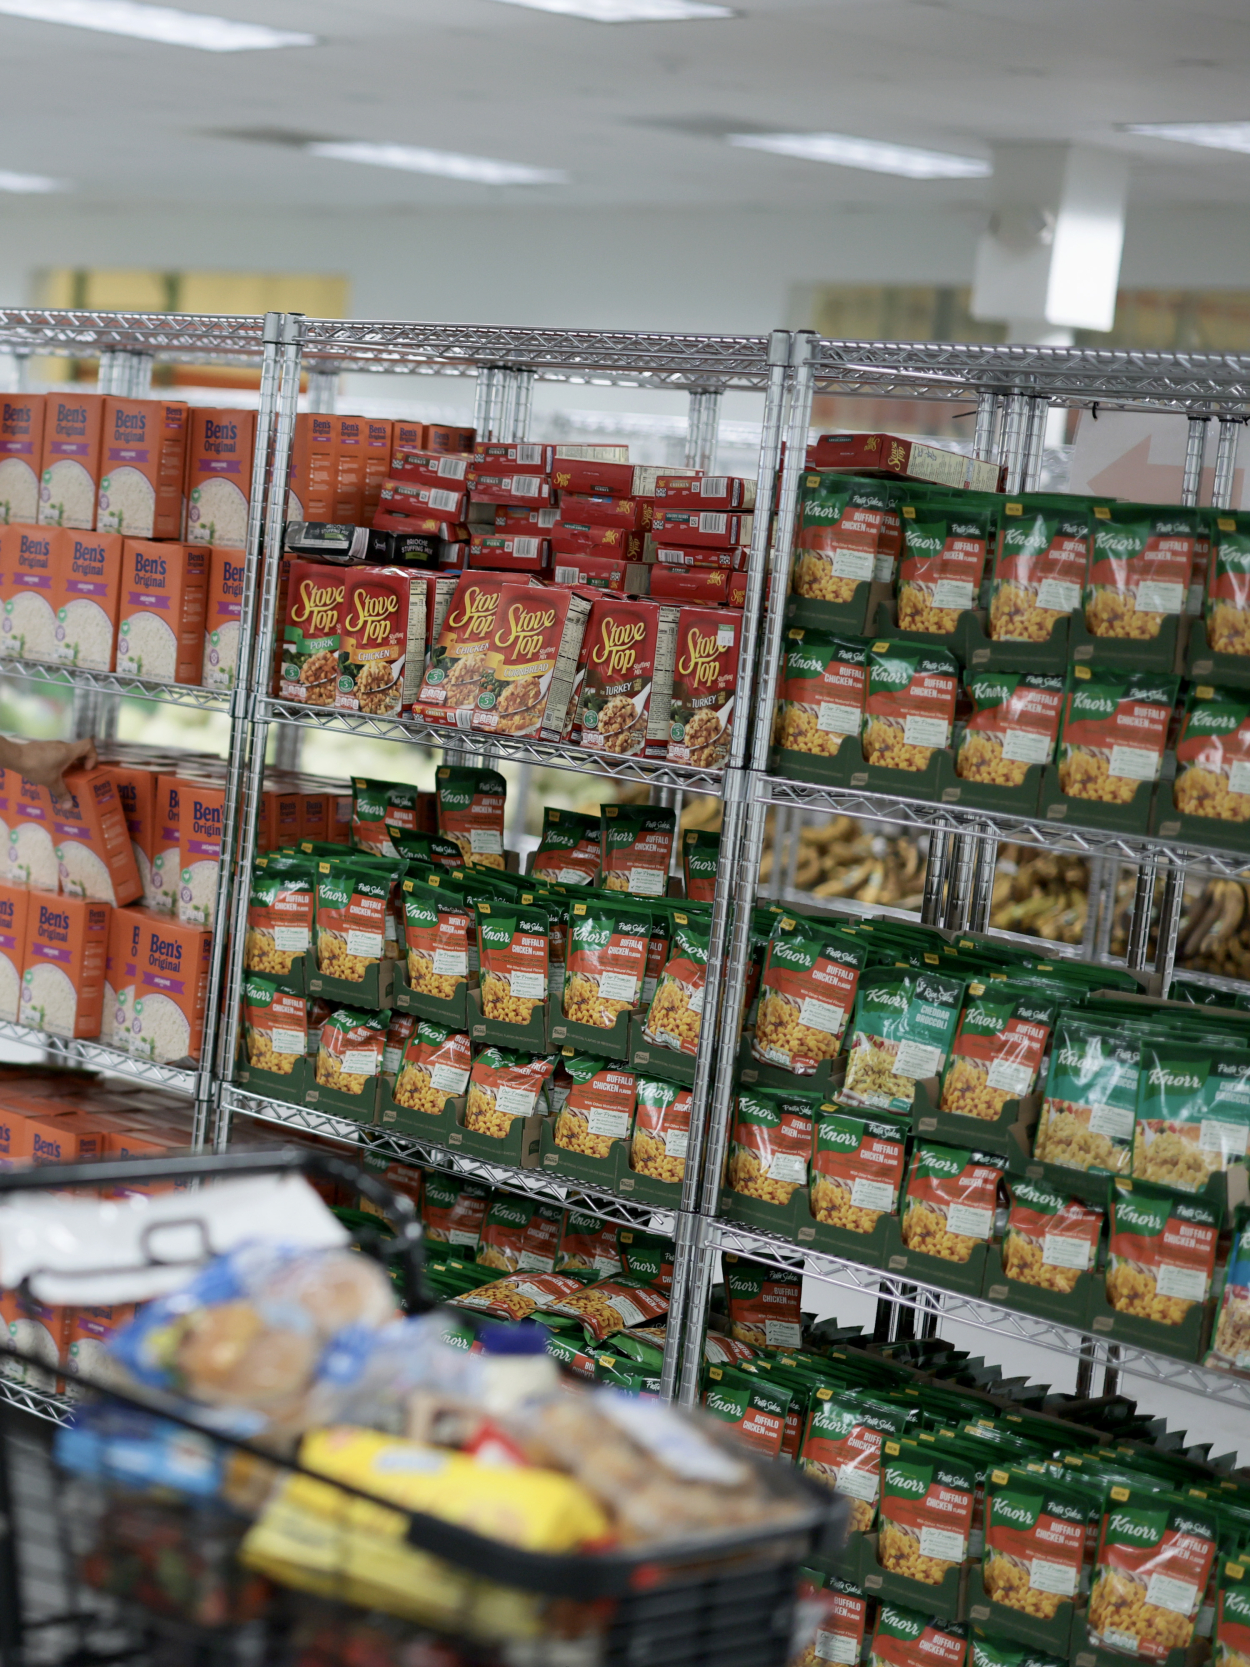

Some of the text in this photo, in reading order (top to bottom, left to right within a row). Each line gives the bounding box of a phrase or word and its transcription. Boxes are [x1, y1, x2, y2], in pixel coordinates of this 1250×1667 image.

[3, 404, 31, 422] Ben's
[57, 404, 86, 423] Ben's
[115, 410, 146, 429] Ben's
[114, 430, 144, 443] Original
[205, 420, 237, 440] Ben's
[204, 440, 236, 454] Original
[804, 500, 840, 520] Knorr
[854, 512, 880, 523] BUFFALO
[841, 521, 865, 532] CHICKEN
[20, 535, 49, 556] Ben's
[407, 538, 429, 548] BRIOCHE
[905, 531, 942, 550] Knorr
[1095, 532, 1142, 550] Knorr
[73, 541, 105, 562] Ben's
[72, 561, 103, 576] Original
[135, 553, 166, 575] Ben's
[134, 573, 165, 588] Original
[291, 580, 345, 622] Stove
[449, 587, 500, 627] Stov
[345, 589, 398, 631] Stove
[309, 608, 338, 633] Top
[495, 604, 555, 647] Stove
[362, 617, 391, 644] Top
[310, 639, 334, 649] PORK
[456, 643, 490, 654] CHICKEN
[511, 634, 543, 660] Top
[593, 618, 646, 663] Stove
[358, 650, 390, 661] CHICKEN
[607, 648, 635, 676] Top
[788, 653, 824, 672] Knorr
[504, 663, 549, 678] CORNBREAD
[693, 660, 719, 688] Top
[870, 666, 909, 684] Knorr
[824, 674, 853, 686] CHICKEN
[924, 678, 953, 690] BUFFALO
[606, 683, 632, 696] TURKEY
[910, 686, 937, 697] CHICKEN
[692, 695, 717, 708] TURKEY
[1073, 692, 1114, 712] Knorr
[1134, 706, 1166, 720] BUFFALO
[1190, 711, 1238, 728] Knorr
[1117, 715, 1149, 728] CHICKEN
[319, 885, 348, 903] Knorr
[274, 902, 297, 910] CHICKEN
[350, 906, 371, 916] CHICKEN
[361, 899, 382, 910] BUFFALO
[405, 903, 438, 922] Knorr
[39, 906, 69, 930] Ben's
[38, 925, 68, 943] Original
[481, 925, 510, 943] Knorr
[522, 937, 544, 947] BUFFALO
[573, 927, 610, 944] Knorr
[150, 933, 182, 960] Ben's
[512, 945, 532, 955] CHICKEN
[608, 946, 629, 956] CHICKEN
[773, 941, 812, 967] Knorr
[149, 954, 181, 973] Original
[812, 970, 838, 985] CHICKEN
[826, 965, 854, 980] BUFFALO
[246, 984, 271, 1002] Knorr
[272, 1004, 294, 1014] CHICKEN
[283, 998, 303, 1008] BUFFALO
[921, 1005, 950, 1020] CHEDDAR
[965, 1008, 1004, 1029] Knorr
[916, 1013, 948, 1030] BROCCOLI
[1016, 1024, 1044, 1038] BUFFALO
[593, 1081, 618, 1092] CHICKEN
[606, 1074, 633, 1085] BUFFALO
[738, 1097, 780, 1123] Knorr
[818, 1124, 858, 1147] Knorr
[860, 1150, 883, 1163] CHICKEN
[872, 1143, 898, 1156] BUFFALO
[1115, 1204, 1163, 1230] Knorr
[1163, 1233, 1195, 1248] CHICKEN
[1179, 1225, 1212, 1241] BUFFALO
[627, 1255, 658, 1274] Knorr
[763, 1295, 787, 1304] CHICKEN
[774, 1287, 798, 1297] BUFFALO
[707, 1392, 742, 1417] Knorr
[743, 1420, 766, 1435] CHICKEN
[754, 1415, 779, 1429] BUFFALO
[813, 1412, 850, 1435] Knorr
[885, 1468, 926, 1494] Knorr
[926, 1497, 952, 1511] CHICKEN
[939, 1491, 968, 1505] BUFFALO
[993, 1497, 1033, 1525] Knorr
[1050, 1522, 1080, 1537] BUFFALO
[1110, 1514, 1159, 1541] Knorr
[1035, 1528, 1065, 1544] CHICKEN
[880, 1607, 920, 1636] Knorr
[919, 1640, 945, 1656] CHICKEN
[933, 1634, 961, 1650] BUFFALO
